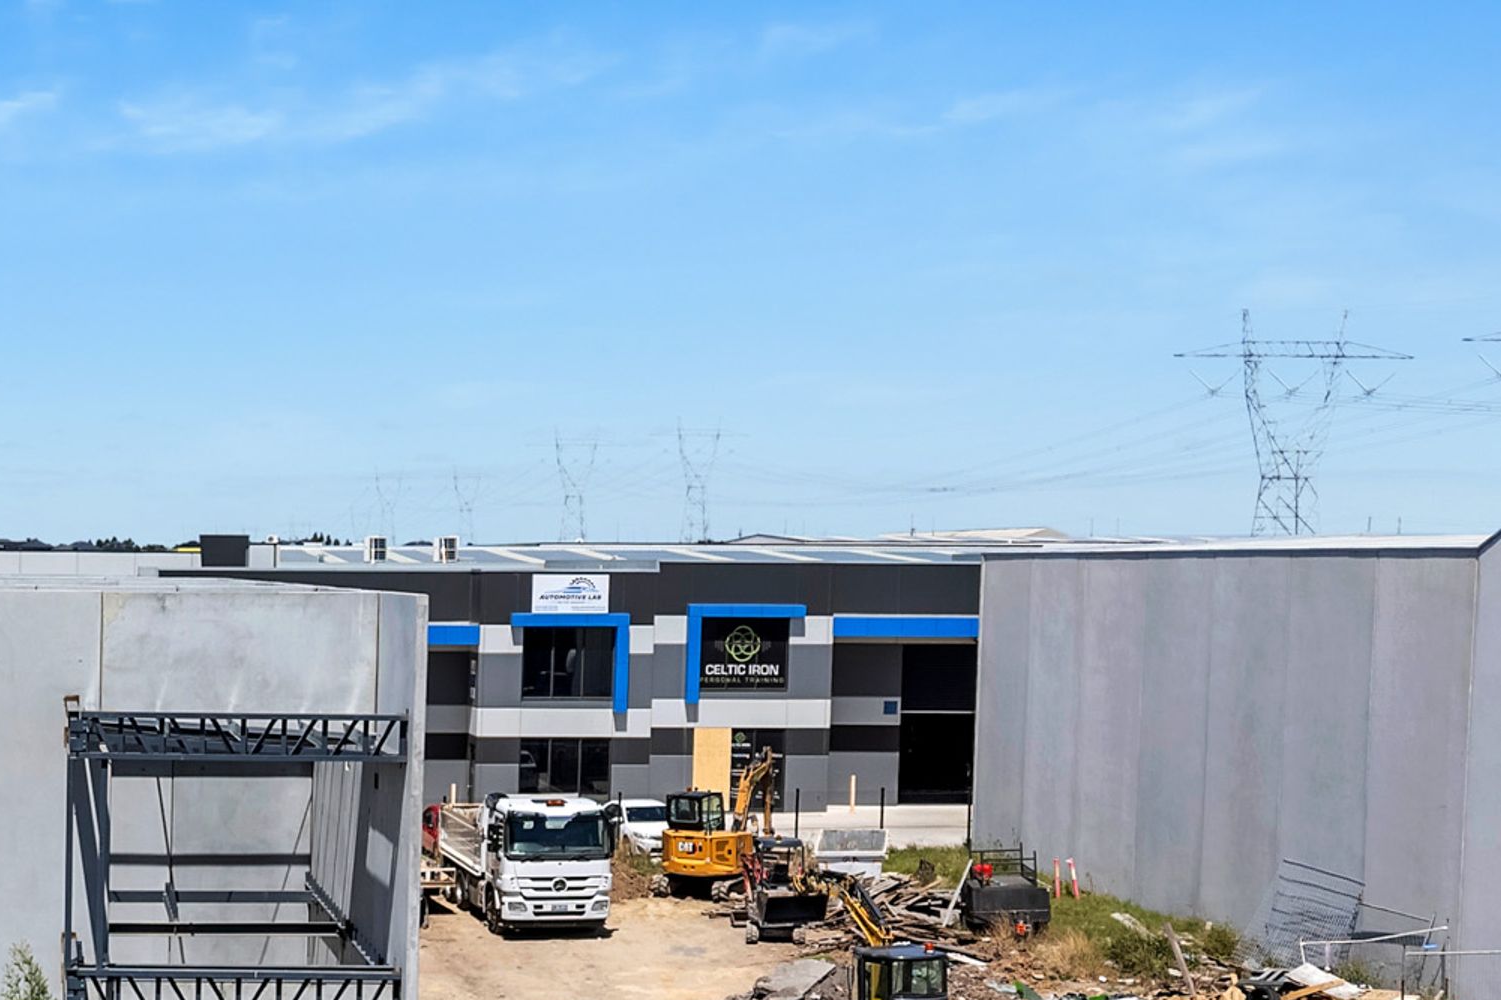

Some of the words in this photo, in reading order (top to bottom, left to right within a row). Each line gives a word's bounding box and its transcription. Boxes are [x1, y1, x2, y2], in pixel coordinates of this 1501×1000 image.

[705, 664, 746, 676] CELTIC
[748, 664, 780, 676] IRON
[700, 676, 742, 684] PERSONAL
[745, 676, 785, 684] TRAINING
